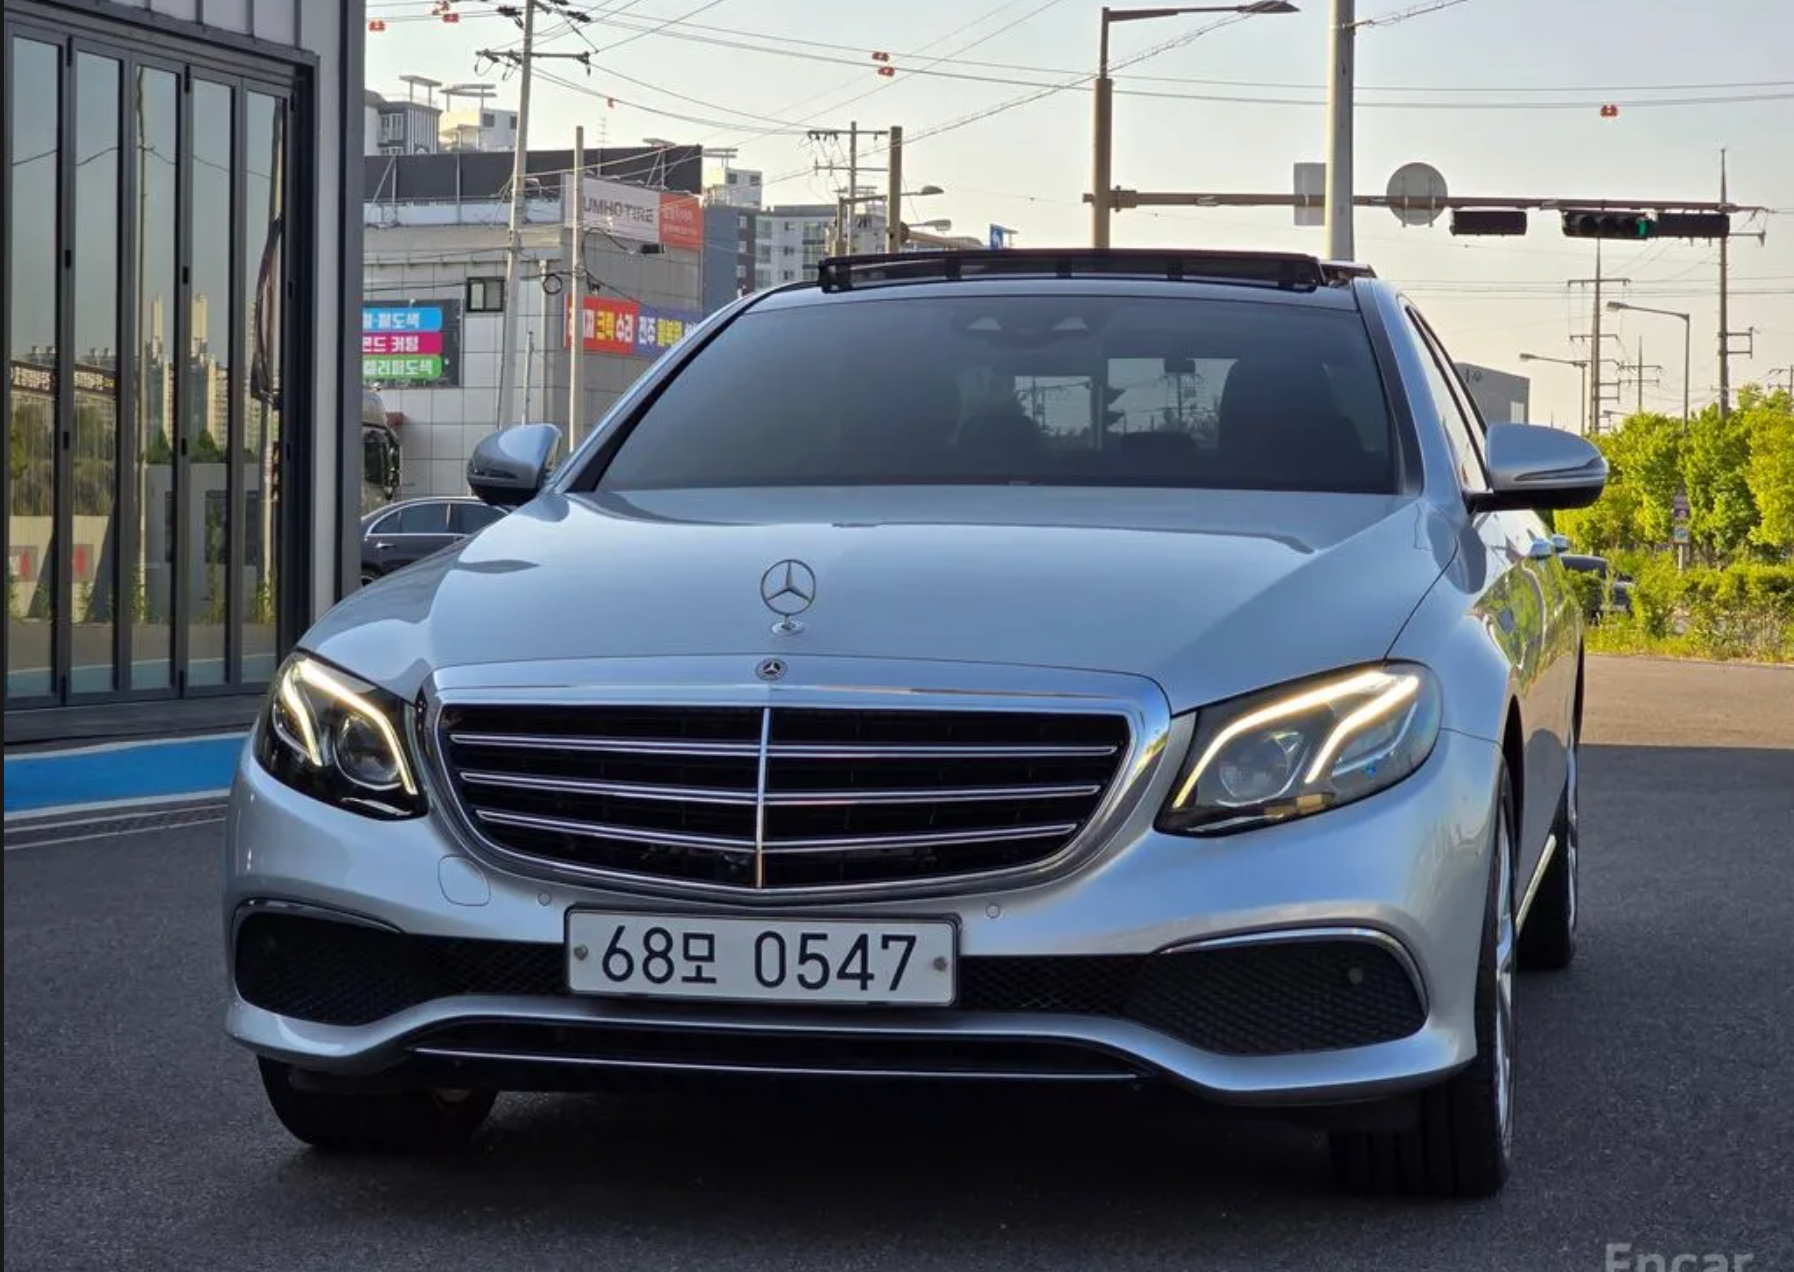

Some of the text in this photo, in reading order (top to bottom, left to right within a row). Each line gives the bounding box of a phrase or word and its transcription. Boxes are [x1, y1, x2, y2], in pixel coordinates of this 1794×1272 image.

[583, 197, 622, 217] UMHO
[624, 203, 654, 223] TIRE
[601, 925, 917, 991] 68모 0547
